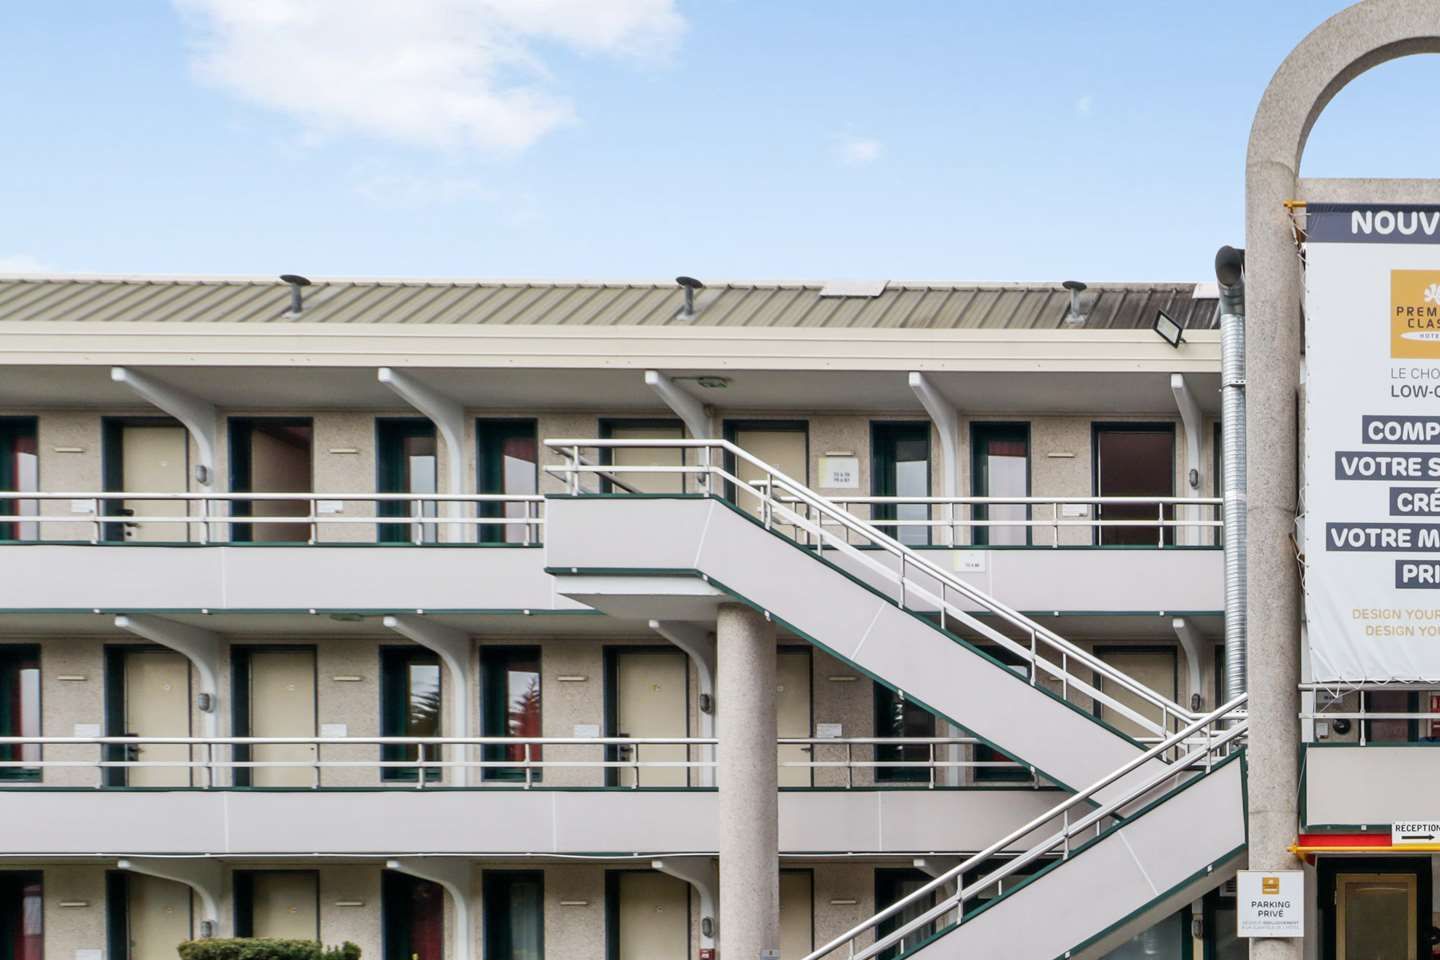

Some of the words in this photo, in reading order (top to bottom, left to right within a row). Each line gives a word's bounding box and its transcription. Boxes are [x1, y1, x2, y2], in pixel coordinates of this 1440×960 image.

[1390, 367, 1407, 379] LE
[1340, 456, 1422, 477] VOTRE
[1330, 528, 1412, 549] VOTRE
[1352, 608, 1401, 620] DESIGN
[1365, 625, 1414, 636] DESIGN
[1251, 901, 1291, 909] PARKING
